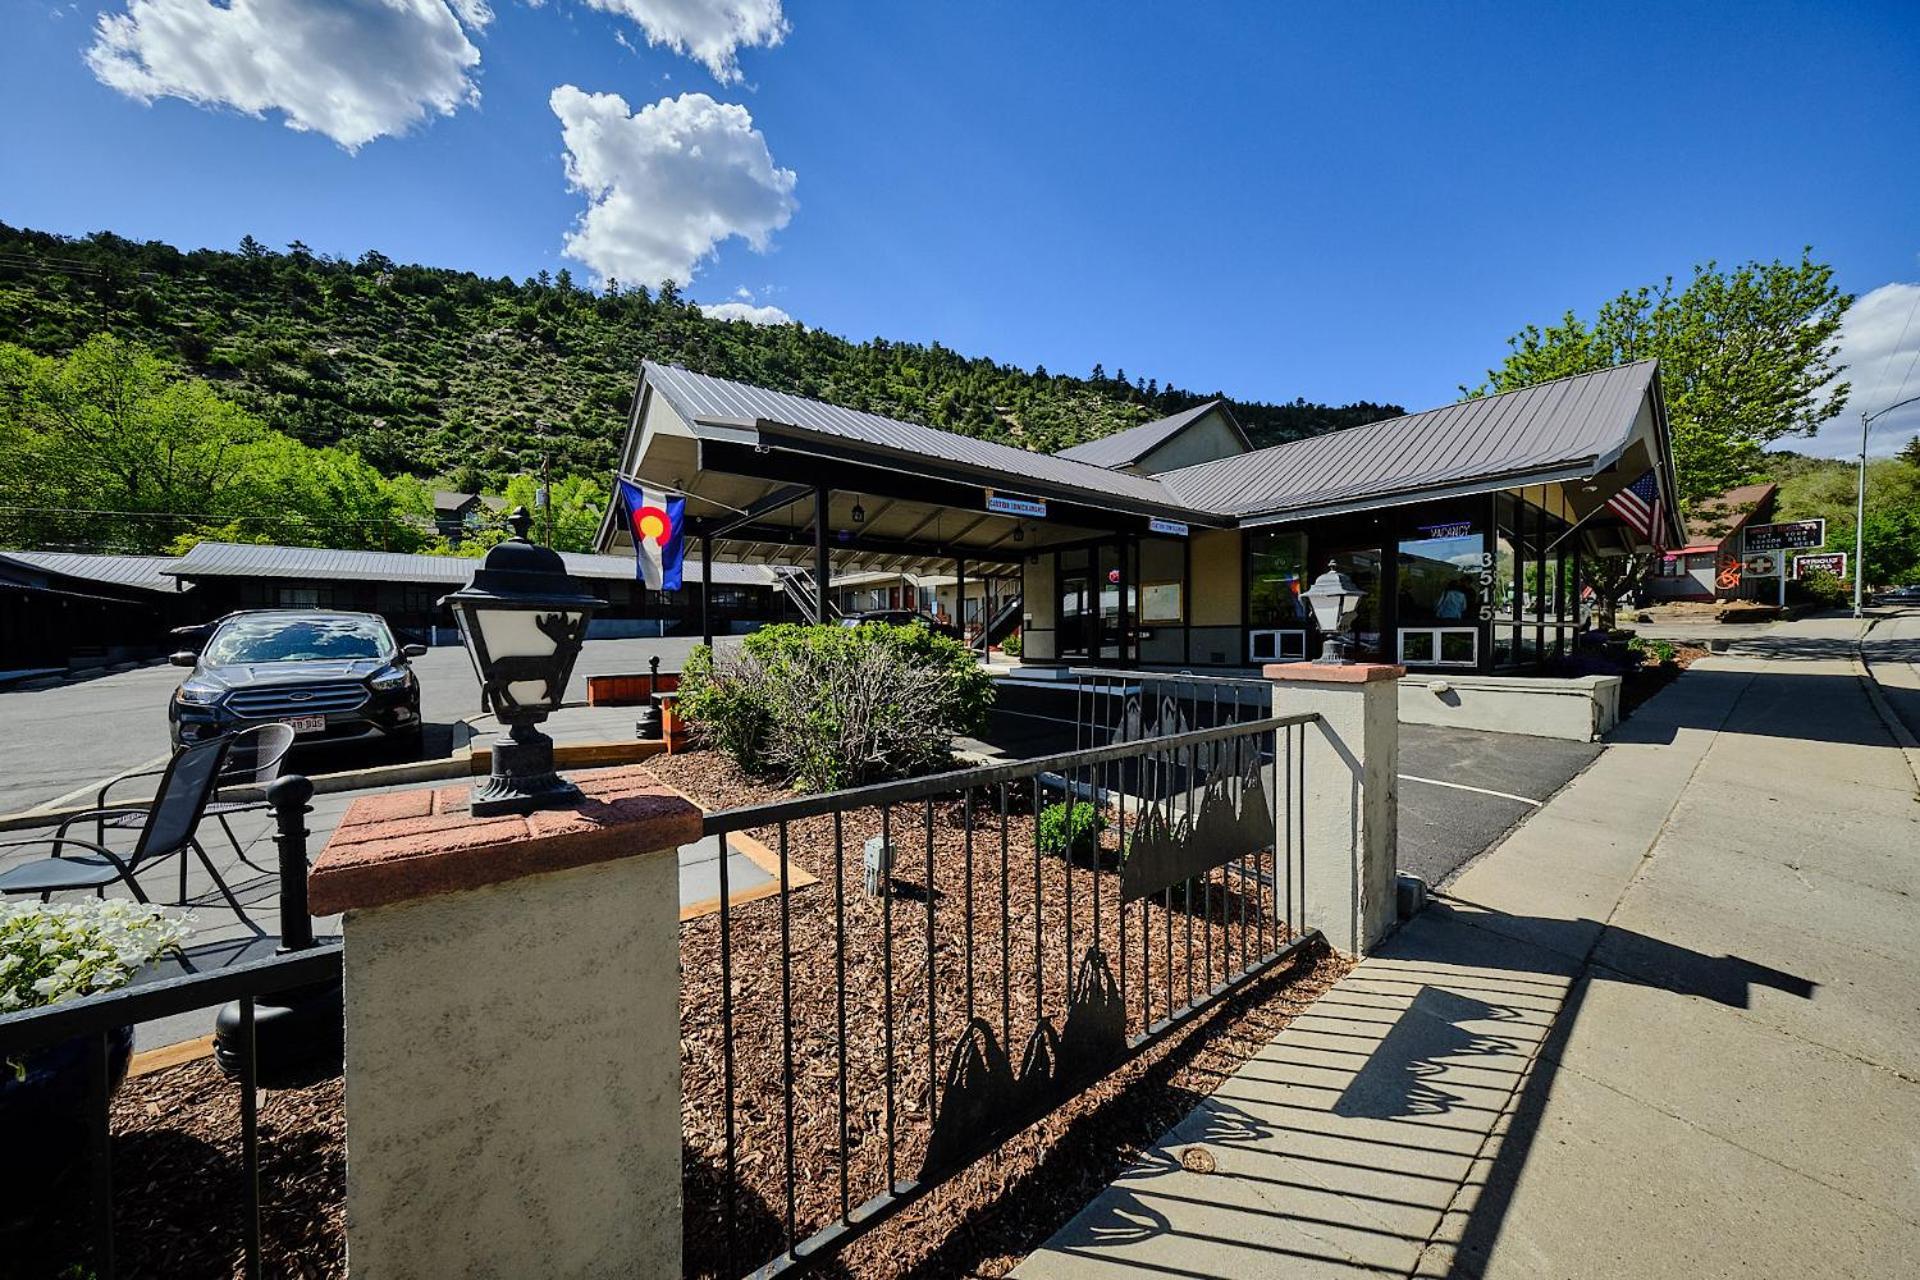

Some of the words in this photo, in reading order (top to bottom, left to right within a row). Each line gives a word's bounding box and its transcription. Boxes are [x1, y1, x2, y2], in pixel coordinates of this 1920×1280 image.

[1430, 525, 1471, 537] VACANCY
[1799, 557, 1839, 565] SERIOUS
[1479, 552, 1493, 620] 3515
